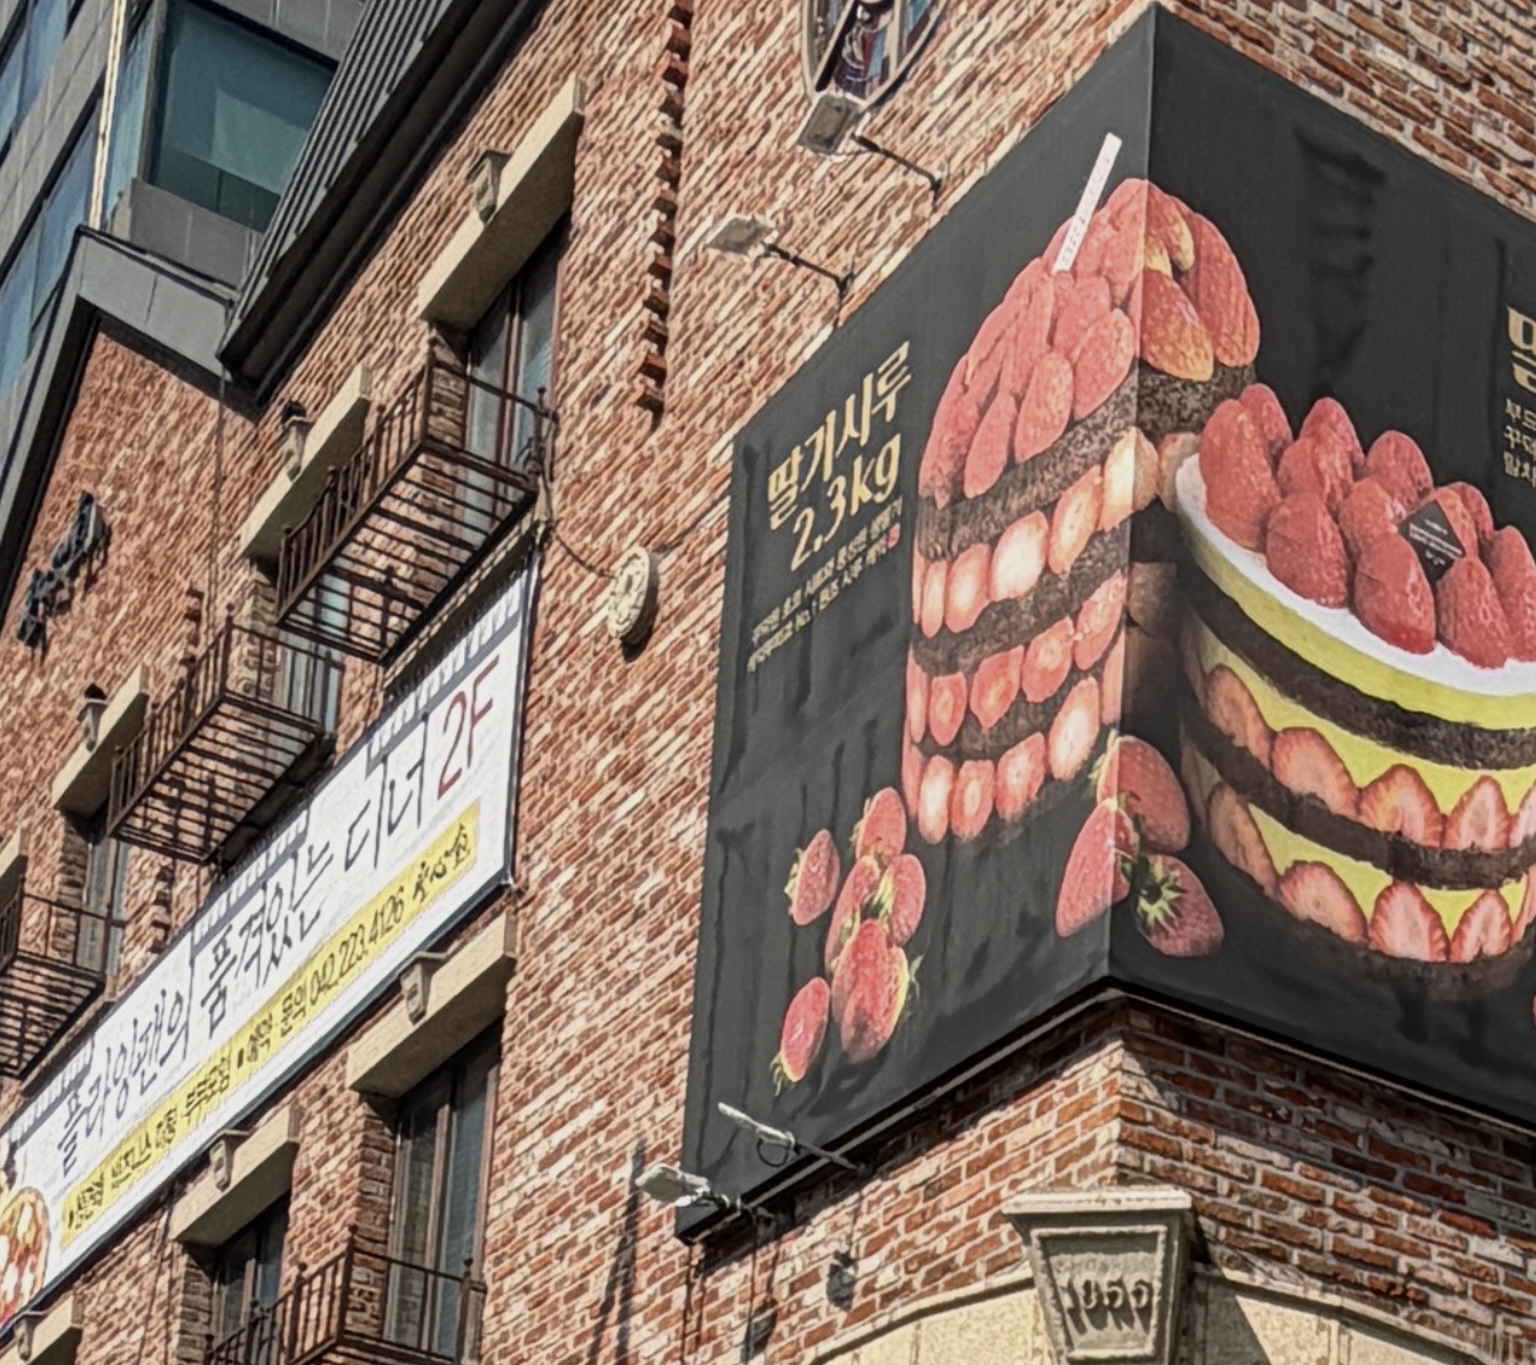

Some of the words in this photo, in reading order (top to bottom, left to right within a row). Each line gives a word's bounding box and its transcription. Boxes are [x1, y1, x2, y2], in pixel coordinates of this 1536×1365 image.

[768, 341, 912, 530] 딸기시루
[791, 433, 899, 572] 2.3kg
[57, 942, 195, 1177] 플라잉팬의
[201, 840, 334, 1039] 품격있는
[344, 713, 428, 873] 디너
[438, 667, 497, 799] 2F
